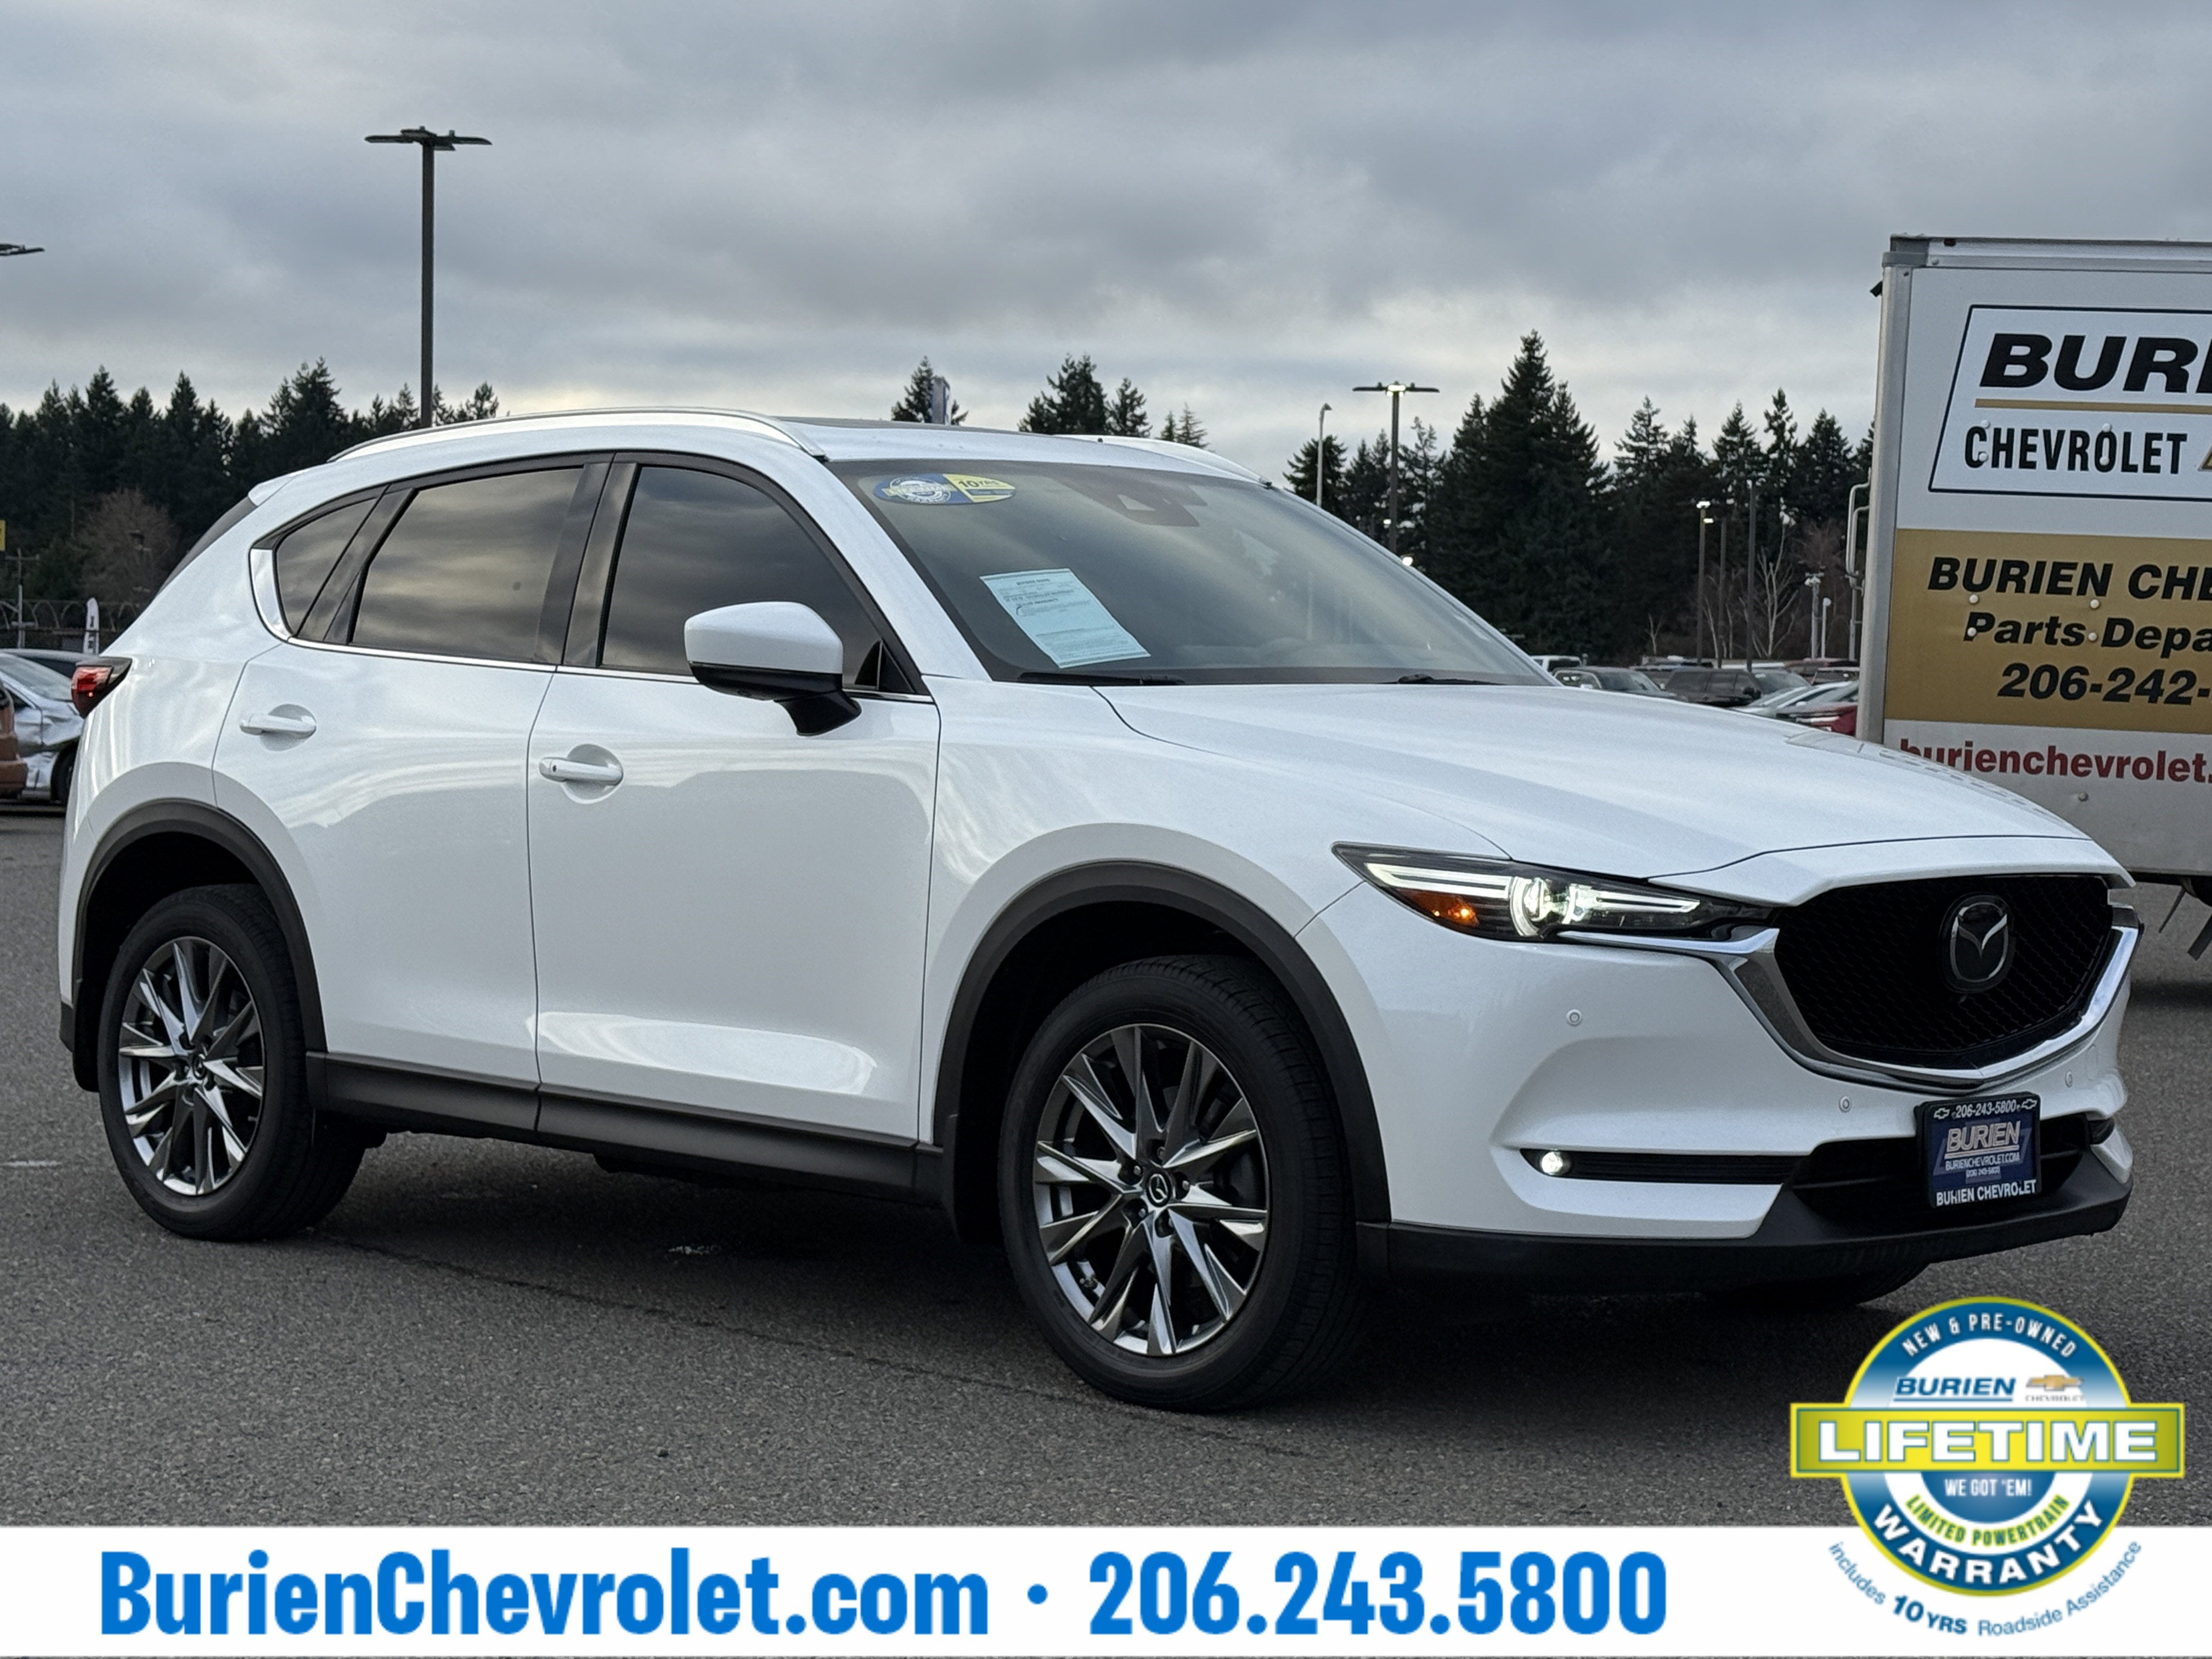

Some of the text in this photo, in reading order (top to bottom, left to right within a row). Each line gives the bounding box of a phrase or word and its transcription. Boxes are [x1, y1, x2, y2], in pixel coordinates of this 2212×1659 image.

[1965, 426, 2188, 475] CHEVROLET
[1928, 556, 2113, 596] BURIEN
[1963, 612, 2086, 647] Parts
[1997, 663, 2211, 706] 206-242-
[1956, 1099, 2016, 1119] 206-243-5800
[1948, 1120, 2021, 1153] BURIEN
[1977, 1180, 2036, 1200] CHEVROLET
